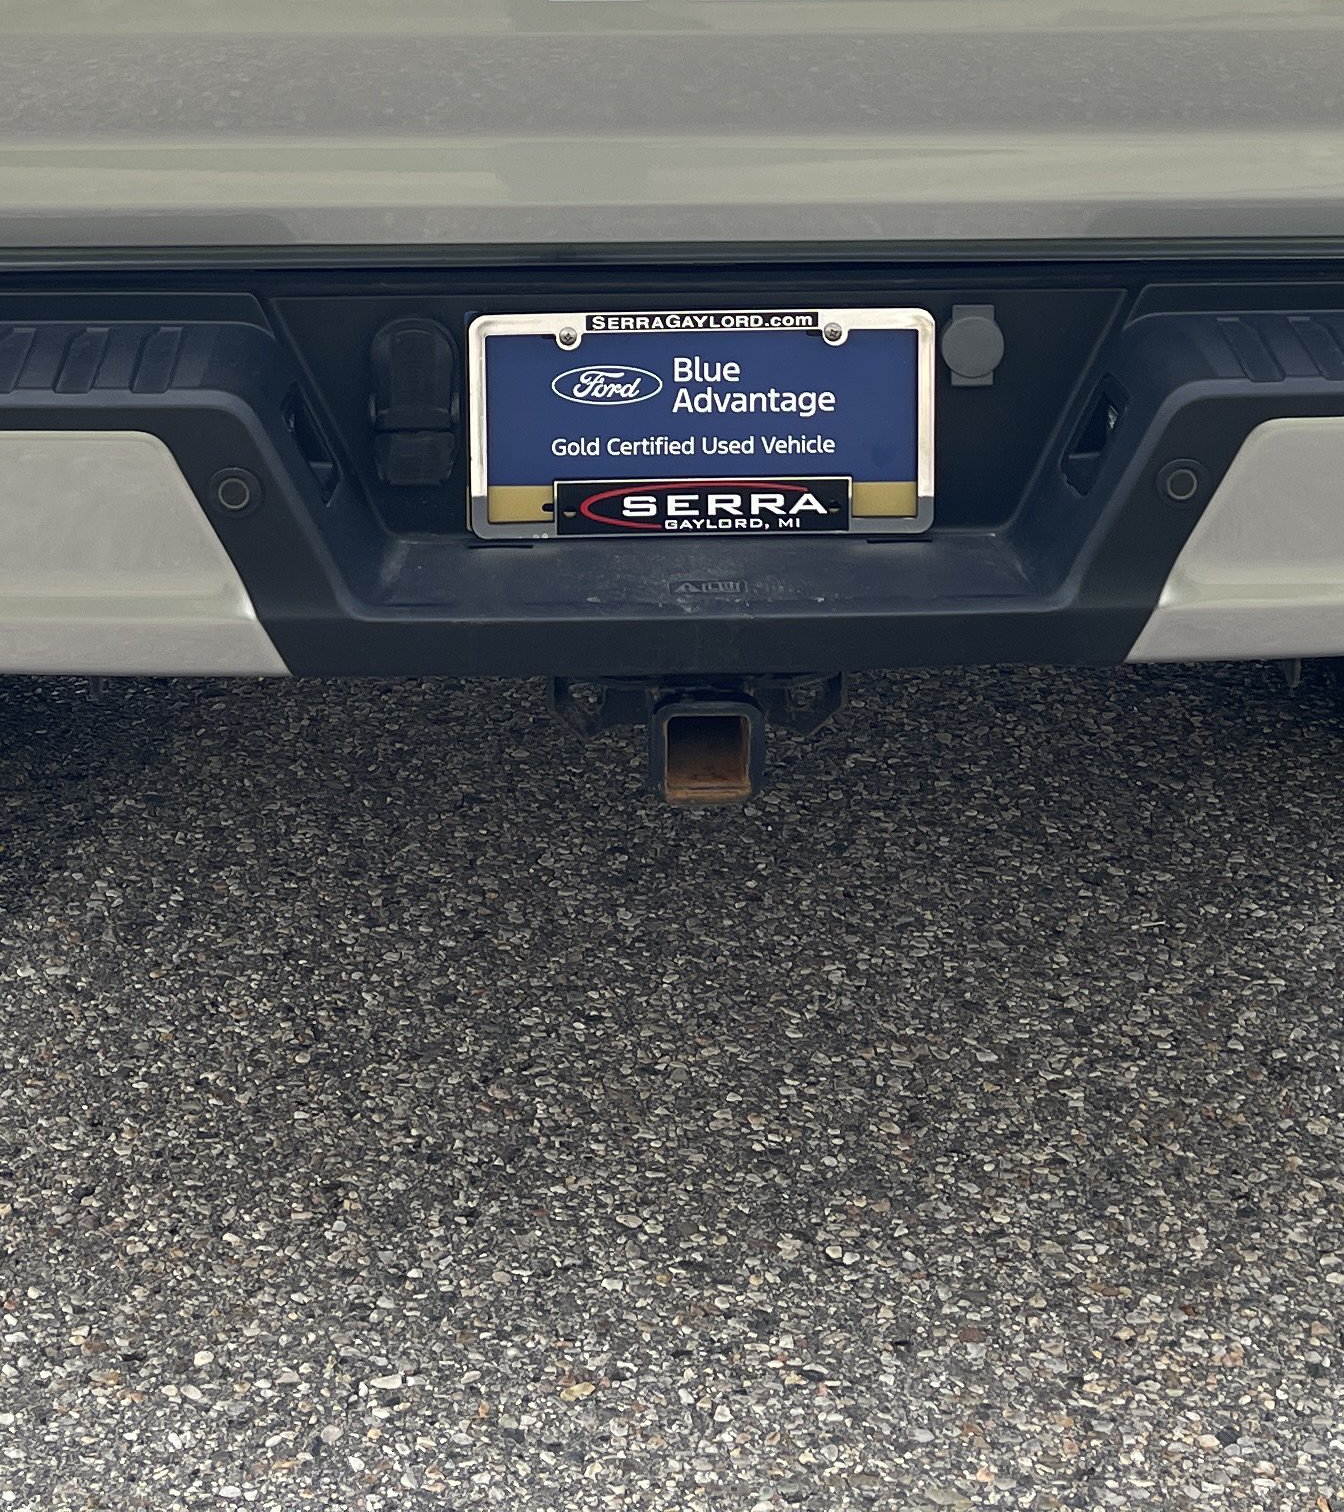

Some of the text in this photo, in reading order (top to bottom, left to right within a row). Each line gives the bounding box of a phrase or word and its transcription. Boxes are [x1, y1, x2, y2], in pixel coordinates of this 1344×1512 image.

[591, 314, 813, 330] SERRAGAYLORD.com
[672, 356, 741, 382] Blue
[572, 370, 642, 399] Ford
[672, 387, 836, 417] Advantage
[551, 435, 836, 456] Gold Certified Used Vehicle
[622, 493, 828, 517] SERRA
[665, 518, 801, 530] GAYLORD, MI
